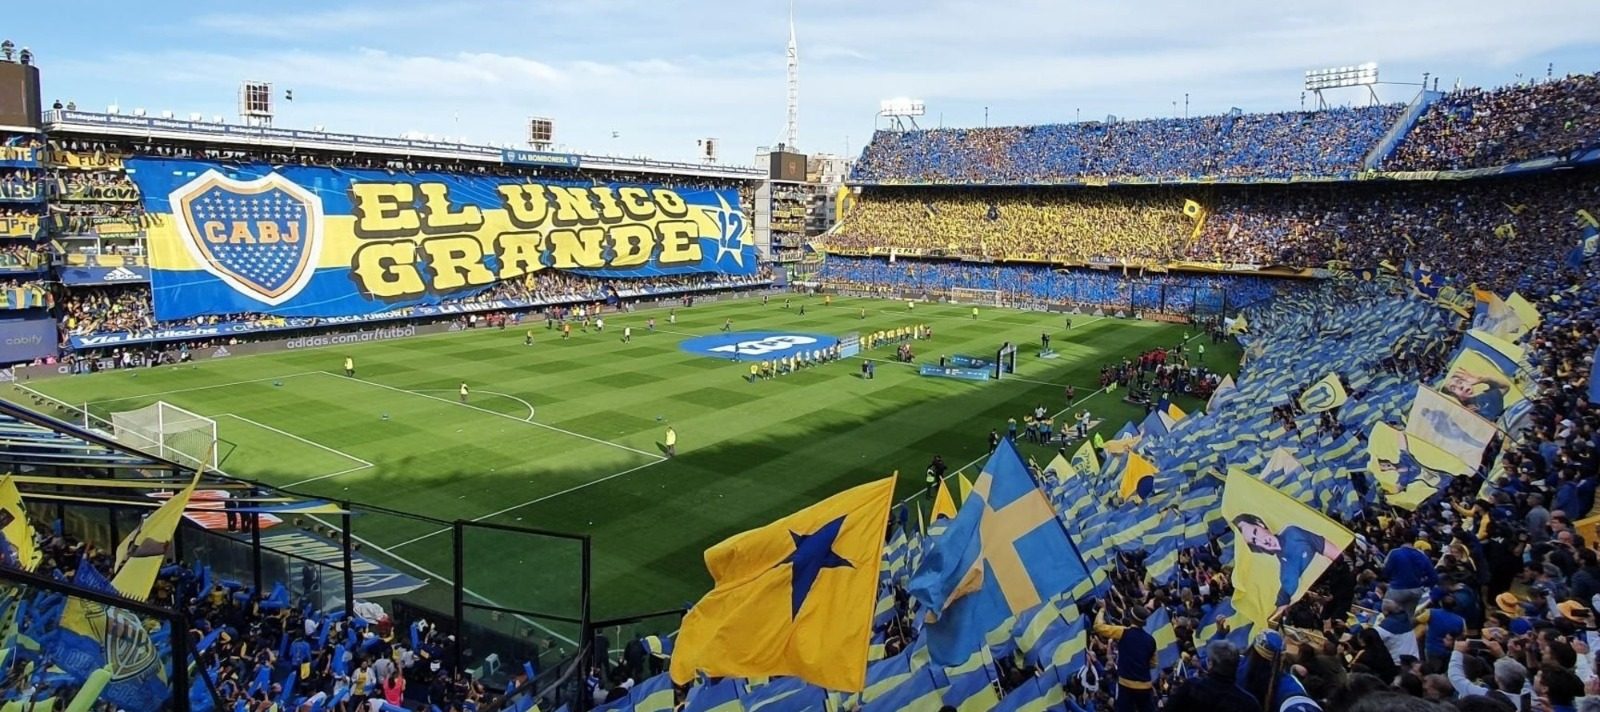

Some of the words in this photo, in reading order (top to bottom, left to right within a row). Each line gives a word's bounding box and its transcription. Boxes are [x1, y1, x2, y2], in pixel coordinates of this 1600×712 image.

[518, 153, 526, 162] LA
[528, 154, 569, 164] BOMBONERA
[352, 182, 484, 239] EL
[497, 183, 689, 229] UNICO
[204, 220, 299, 244] CABJ
[718, 210, 744, 250] 12
[351, 219, 703, 297] GRANDE
[328, 314, 362, 324] BOCA
[6, 335, 42, 344] cabify
[286, 326, 415, 349] adidas.com.ar/futbol
